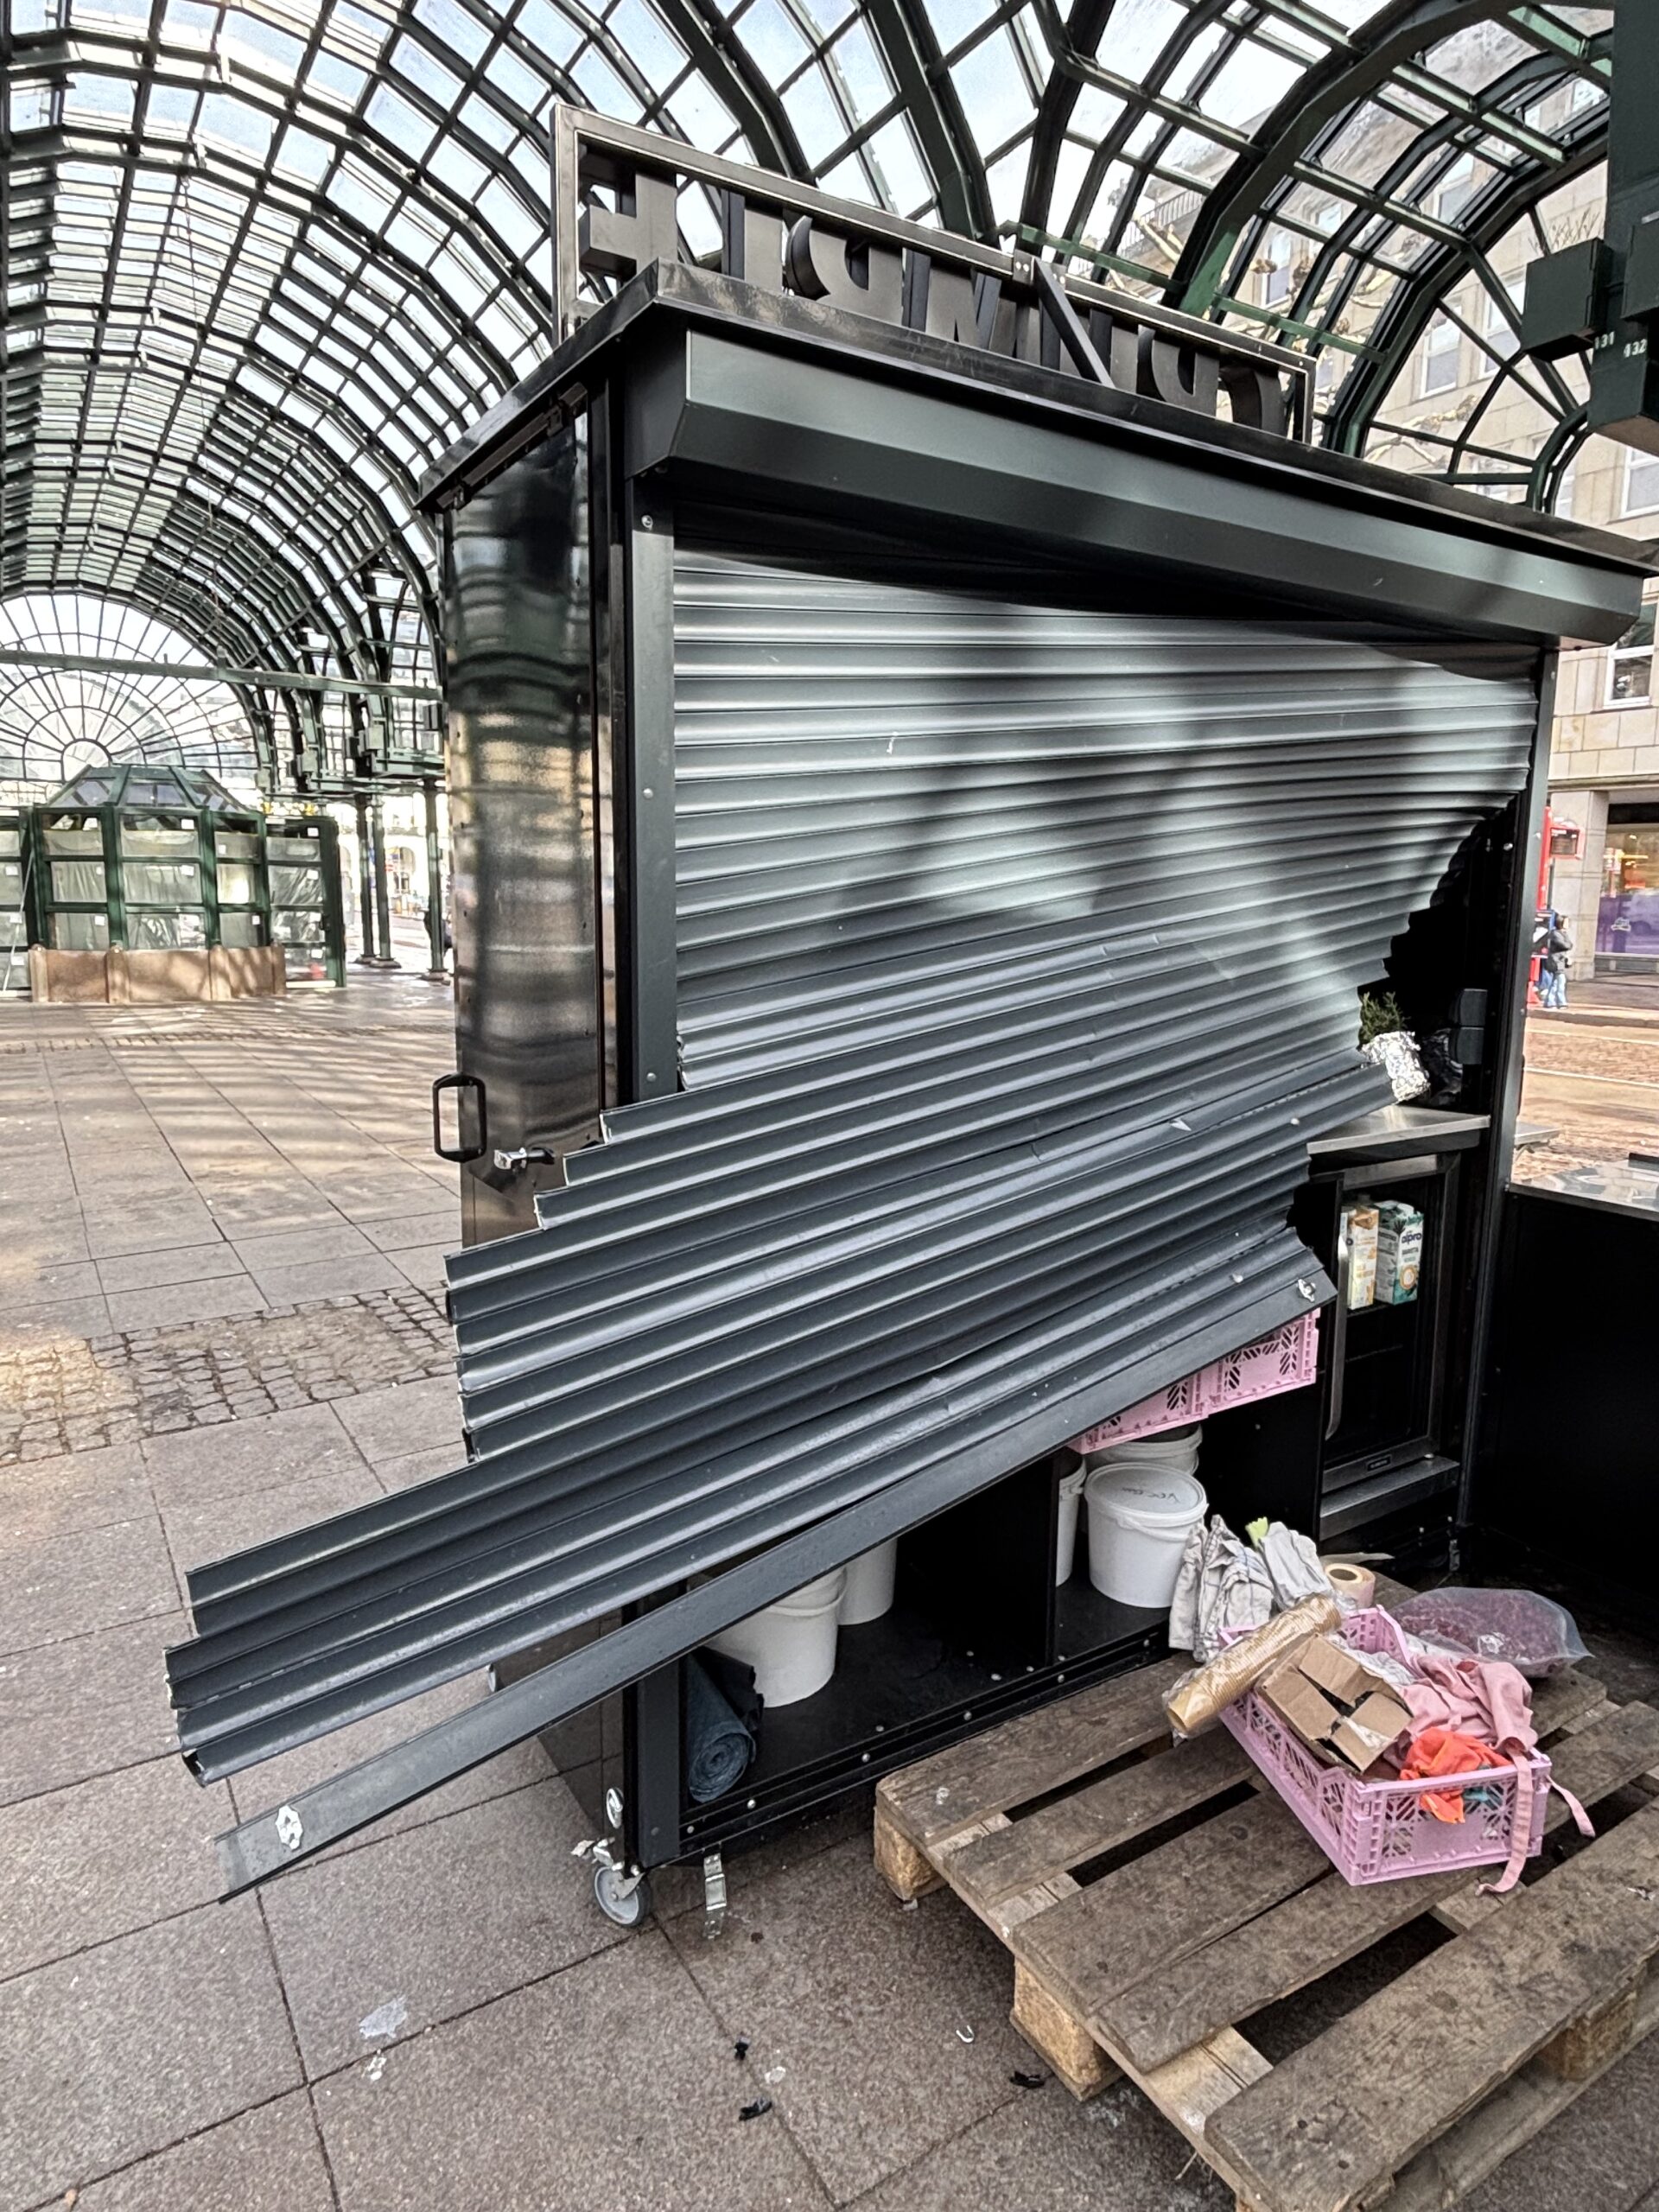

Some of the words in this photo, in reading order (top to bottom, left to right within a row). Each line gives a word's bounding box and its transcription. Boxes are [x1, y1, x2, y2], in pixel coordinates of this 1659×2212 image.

[1594, 330, 1615, 350] 131
[1624, 338, 1648, 358] 132
[1401, 1231, 1422, 1245] alpro
